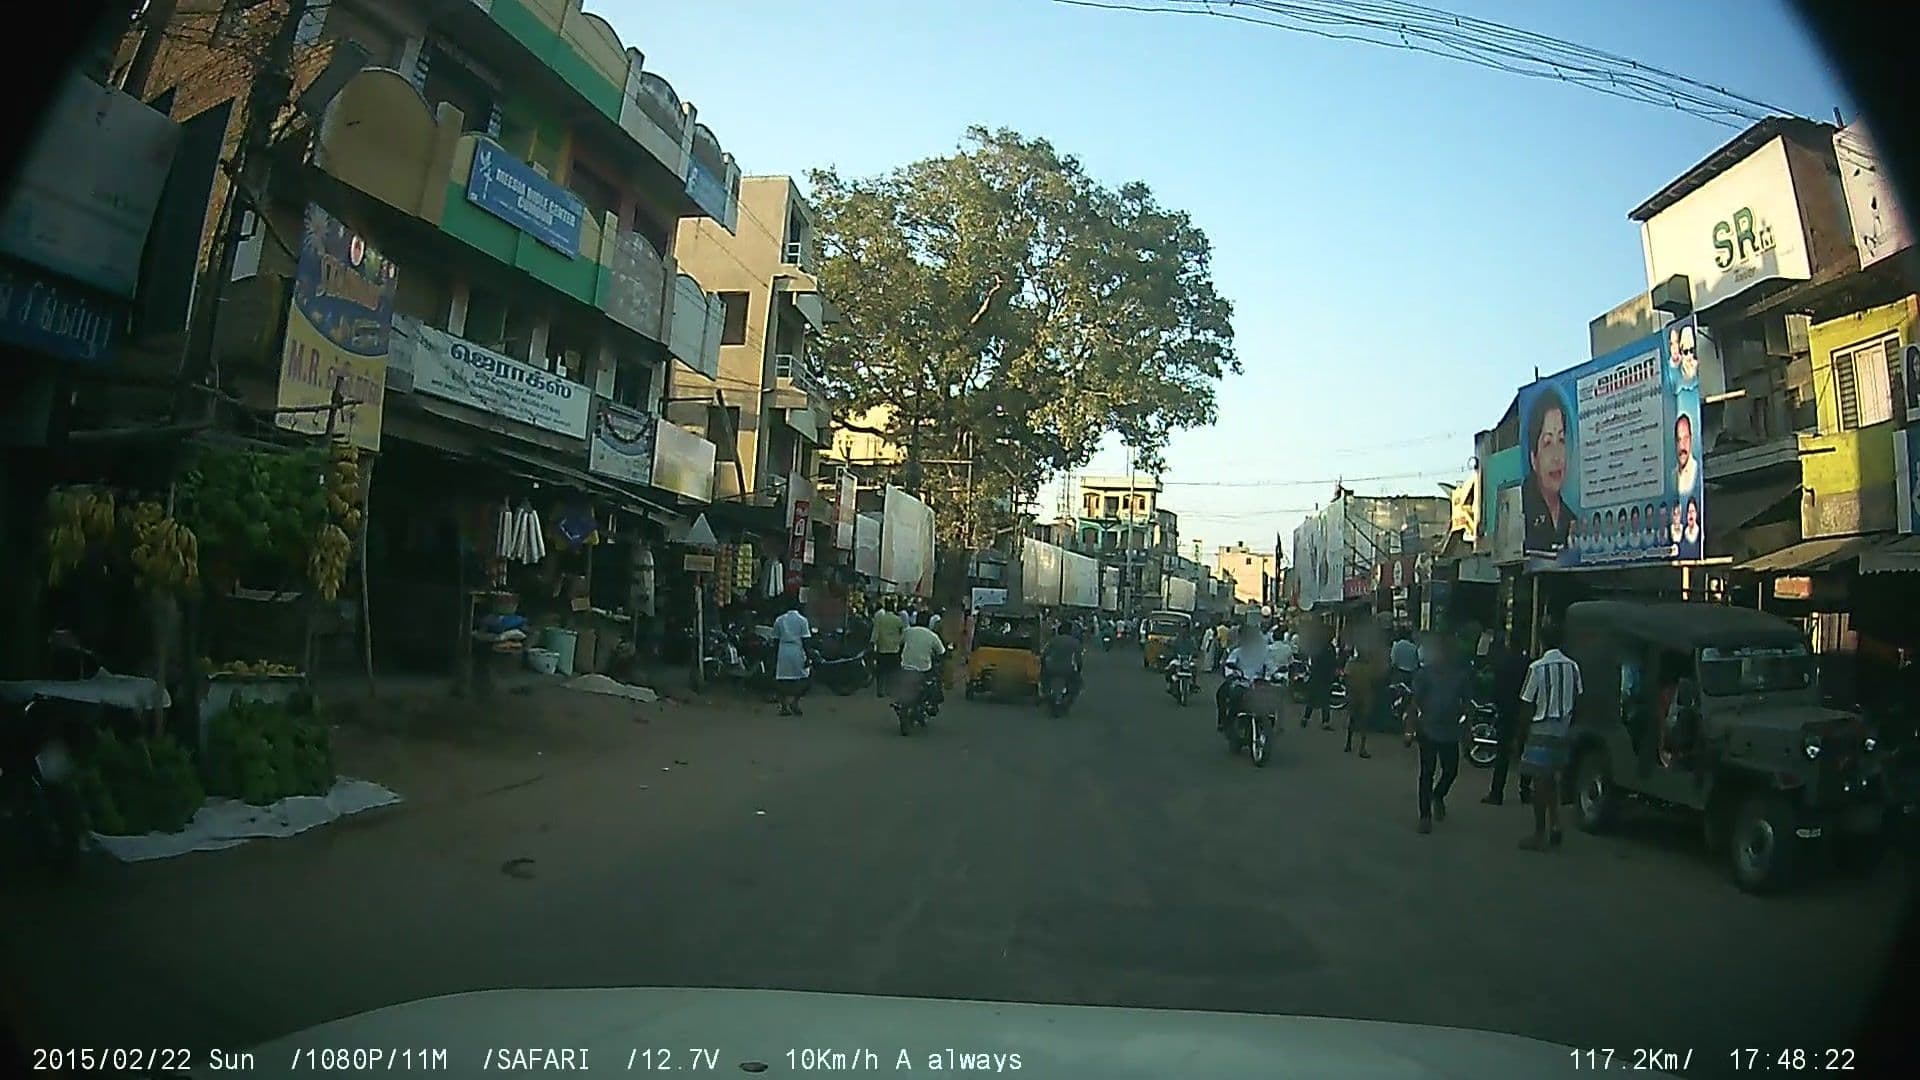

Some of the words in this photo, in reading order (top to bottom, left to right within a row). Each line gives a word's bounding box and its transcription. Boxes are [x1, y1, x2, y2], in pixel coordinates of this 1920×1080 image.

[549, 200, 576, 228] CENTER
[1712, 207, 1760, 269] SR
[450, 341, 573, 400] ஜெராக்ஸ்
